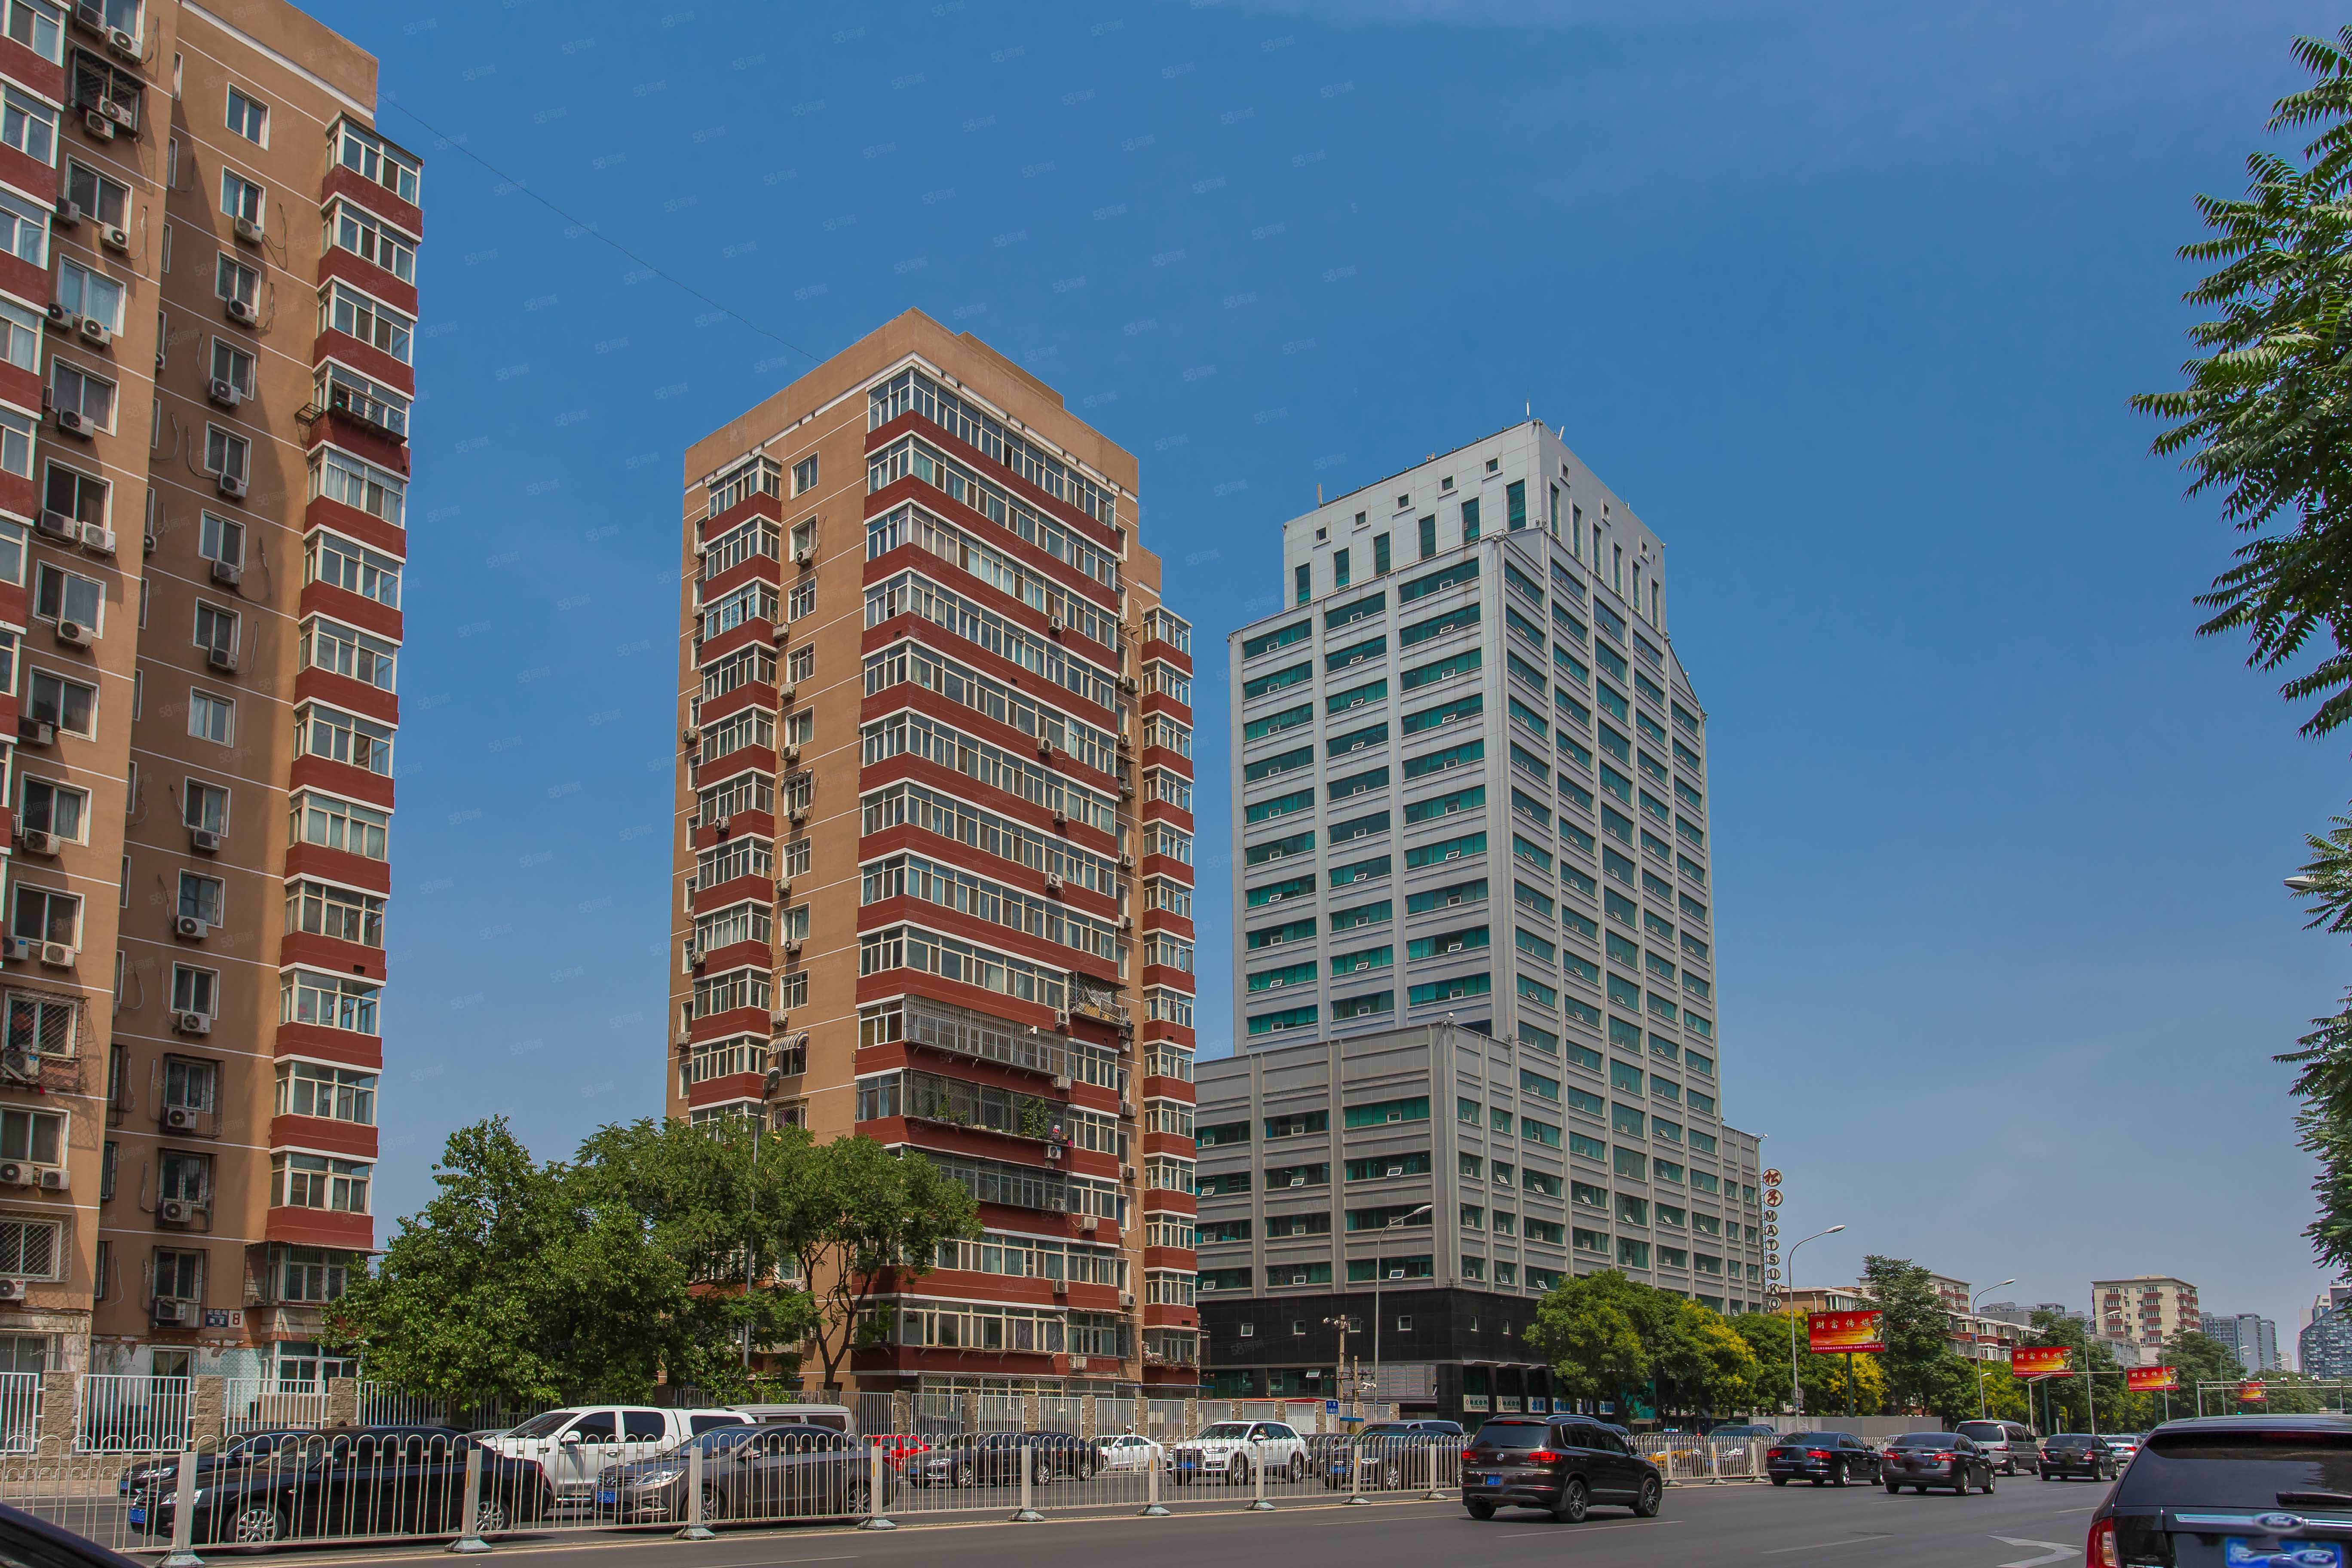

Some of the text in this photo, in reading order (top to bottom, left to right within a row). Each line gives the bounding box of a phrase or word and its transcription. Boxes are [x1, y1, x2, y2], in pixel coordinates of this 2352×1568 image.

[1764, 1170, 1779, 1308] 松子 MATSUKO
[233, 1313, 240, 1325] 8
[1816, 1317, 1871, 1329] 财富传媒
